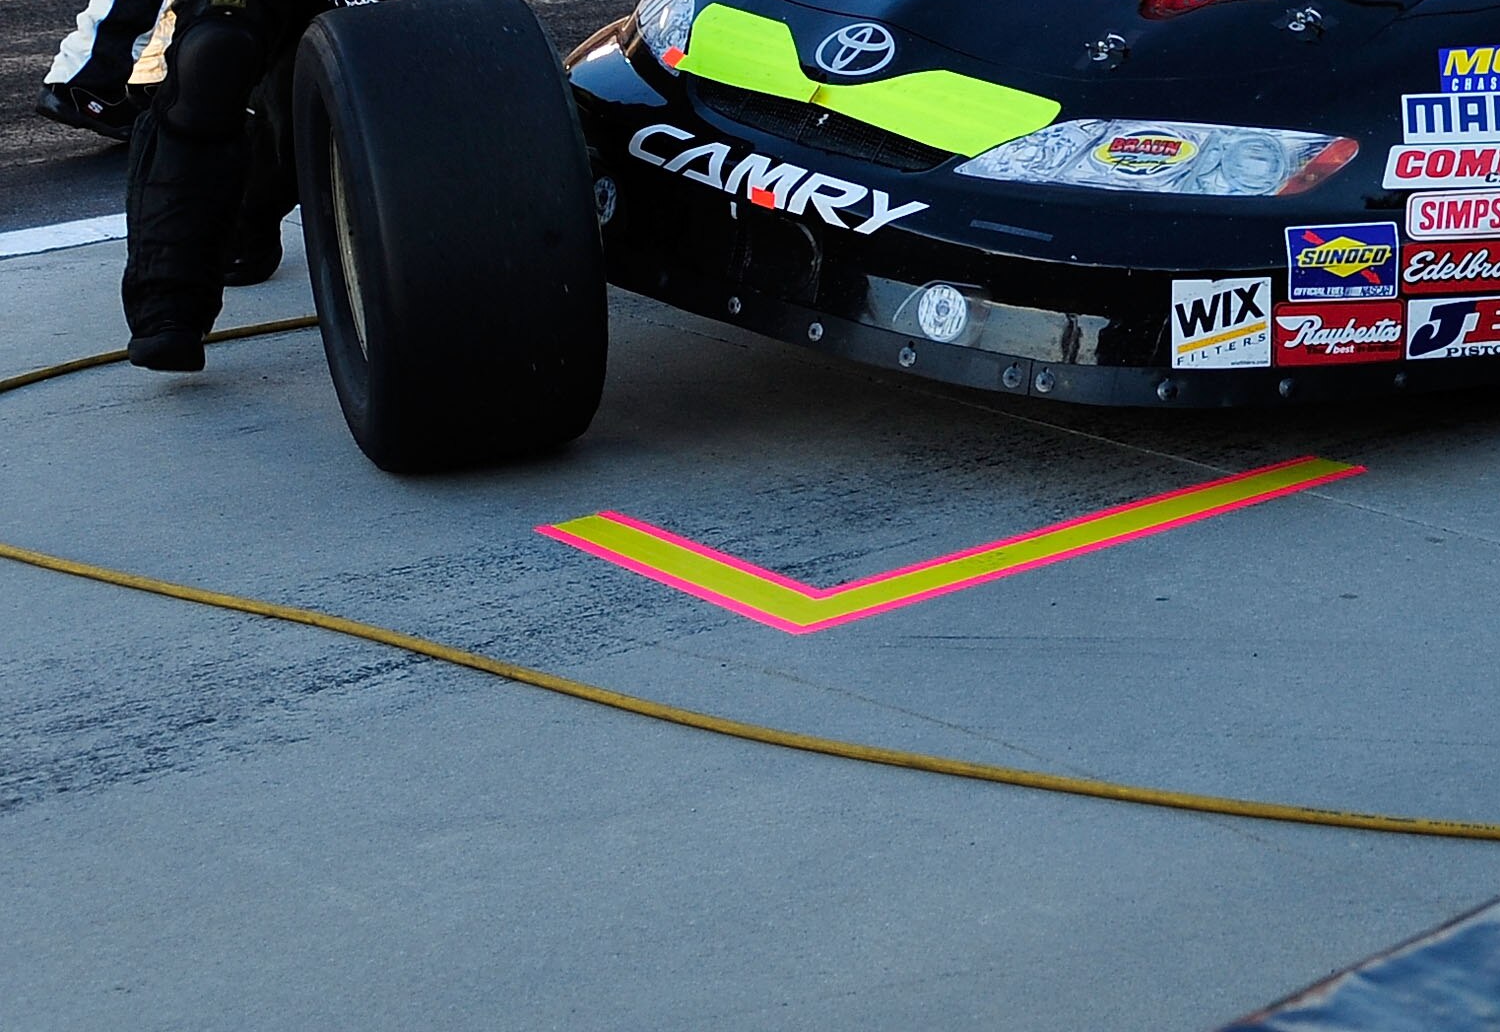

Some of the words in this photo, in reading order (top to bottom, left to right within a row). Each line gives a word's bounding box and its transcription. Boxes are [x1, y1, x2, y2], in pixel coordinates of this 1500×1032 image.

[1107, 137, 1182, 157] BRAUN
[628, 123, 930, 235] CAMRY
[1301, 247, 1388, 266] SUNOCO
[1174, 282, 1266, 339] WIX
[1176, 332, 1267, 367] FILTERS
[1333, 344, 1355, 355] best
